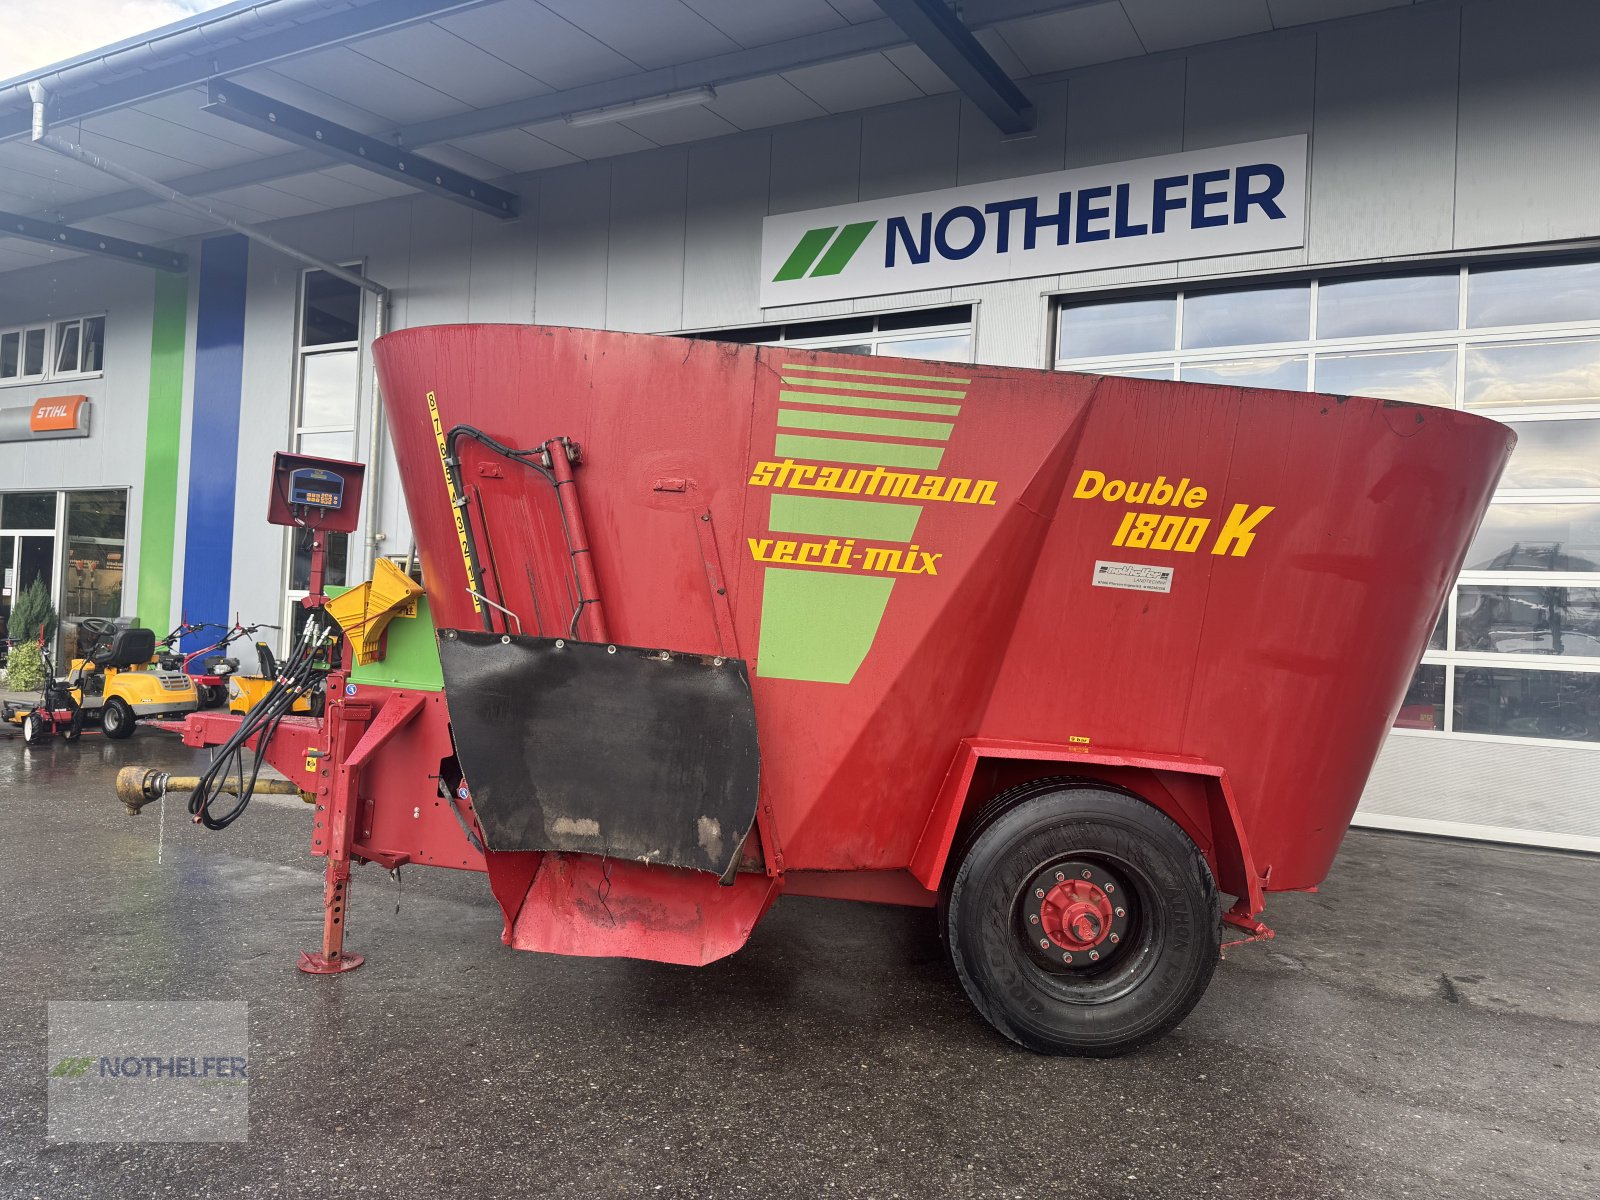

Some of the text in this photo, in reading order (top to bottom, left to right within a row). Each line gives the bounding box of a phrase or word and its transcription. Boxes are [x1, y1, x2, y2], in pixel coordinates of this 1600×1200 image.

[884, 163, 1287, 268] NOTHELFER
[36, 405, 68, 418] STIHL
[428, 394, 435, 407] 8
[433, 418, 440, 432] 7
[456, 516, 464, 530] 3
[462, 541, 469, 555] 2
[748, 458, 998, 505] strautmann
[1072, 469, 1208, 509] Double
[1111, 503, 1276, 557] 1800 K
[747, 537, 942, 576] verti-mix
